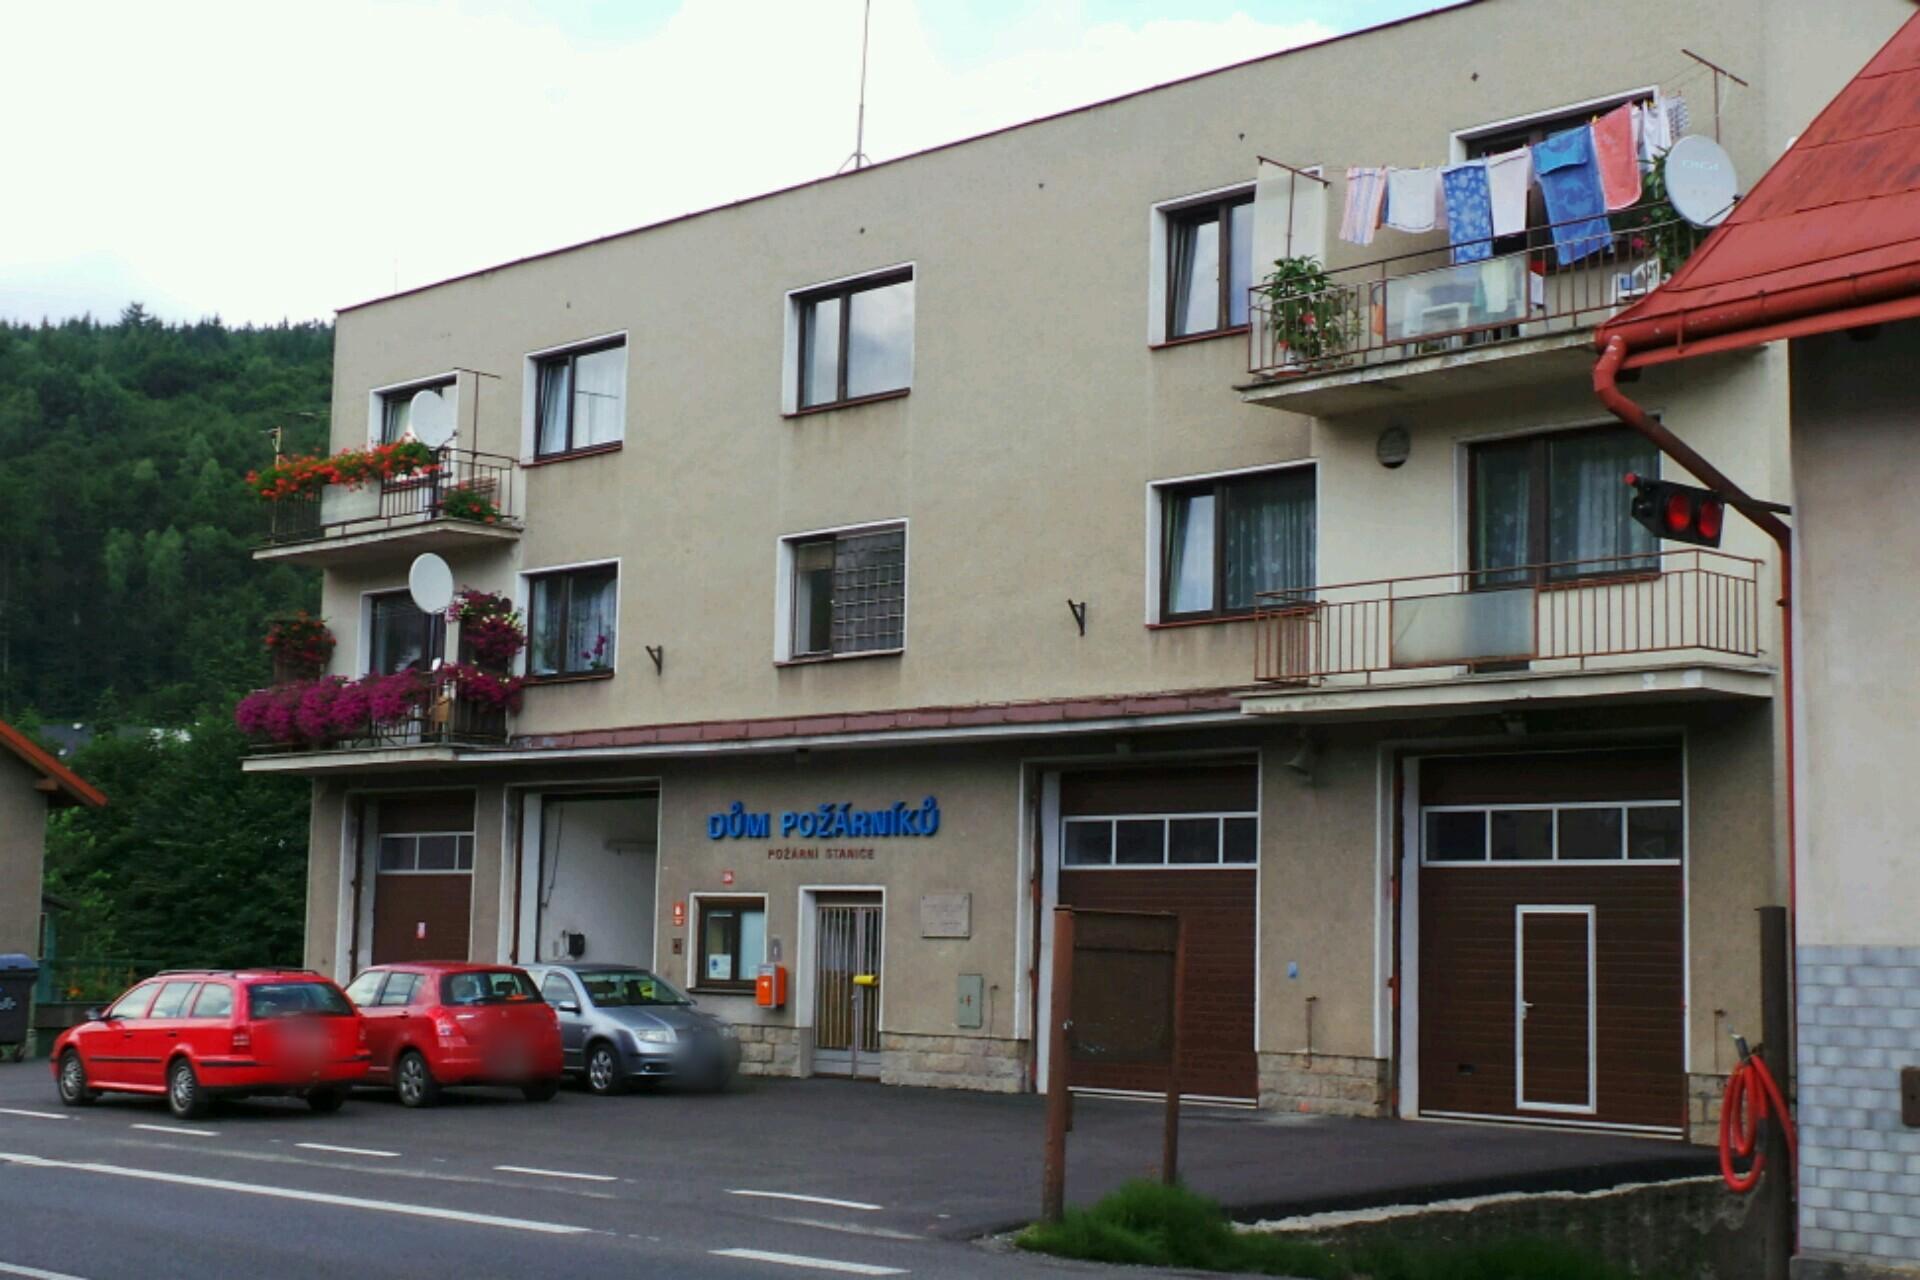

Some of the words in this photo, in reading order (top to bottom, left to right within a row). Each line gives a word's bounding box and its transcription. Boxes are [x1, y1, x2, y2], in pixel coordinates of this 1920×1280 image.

[708, 800, 770, 840] DŮM
[781, 796, 940, 838] POŽÁRNÍKŮ
[768, 847, 818, 860] POŽÁRNÍ
[826, 847, 875, 860] STANICE
